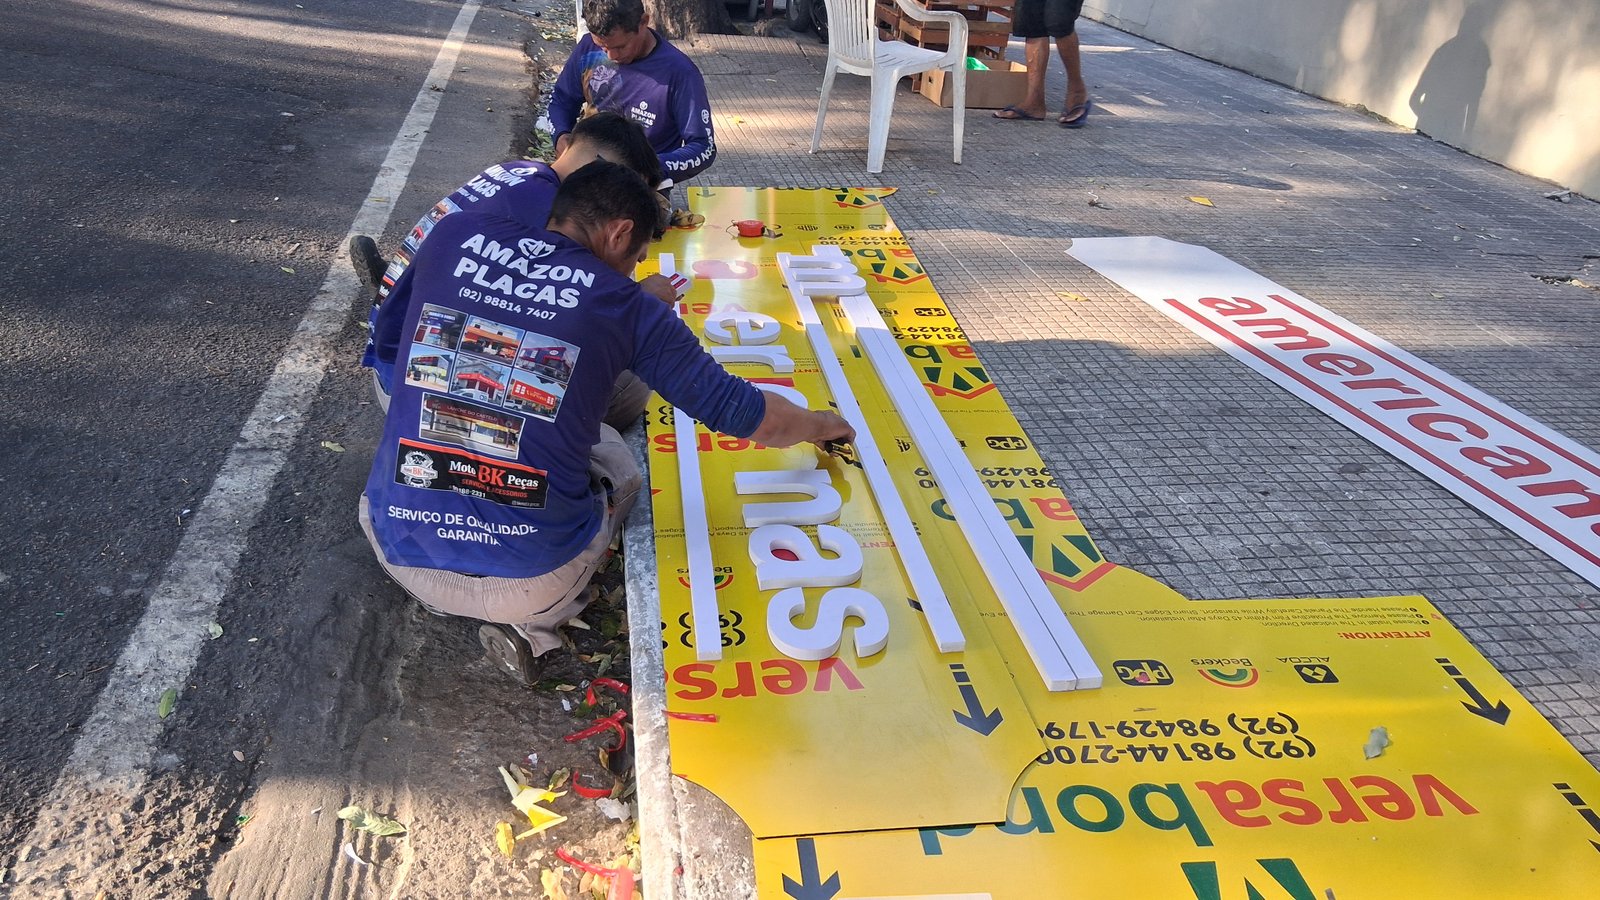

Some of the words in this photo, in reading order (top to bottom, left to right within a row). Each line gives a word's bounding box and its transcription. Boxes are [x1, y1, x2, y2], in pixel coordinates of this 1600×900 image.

[631, 107, 656, 120] AMAZON
[631, 114, 654, 126] PLACAS
[461, 233, 596, 288] AMAZON
[453, 256, 581, 308] PLACAS
[458, 286, 482, 302] (92)
[484, 295, 522, 314] 98814
[526, 307, 557, 320] 7407
[914, 308, 946, 316] PPG
[1198, 296, 1600, 537] american
[985, 436, 1027, 450] PPG
[450, 460, 476, 475] Moto
[478, 465, 506, 487] BK
[507, 474, 538, 490] Peças
[388, 505, 441, 524] SERVIÇO
[445, 514, 464, 526] DE
[466, 516, 538, 536] QUALIDADE
[437, 528, 502, 546] GARANTIA
[1337, 630, 1432, 640] ATTENTION:
[1190, 657, 1252, 668] Beckers
[1275, 656, 1330, 664] ALCOA
[664, 657, 864, 700] vers
[1114, 660, 1173, 686] PPG
[1227, 712, 1298, 736] (92)
[1242, 734, 1316, 759] (92)
